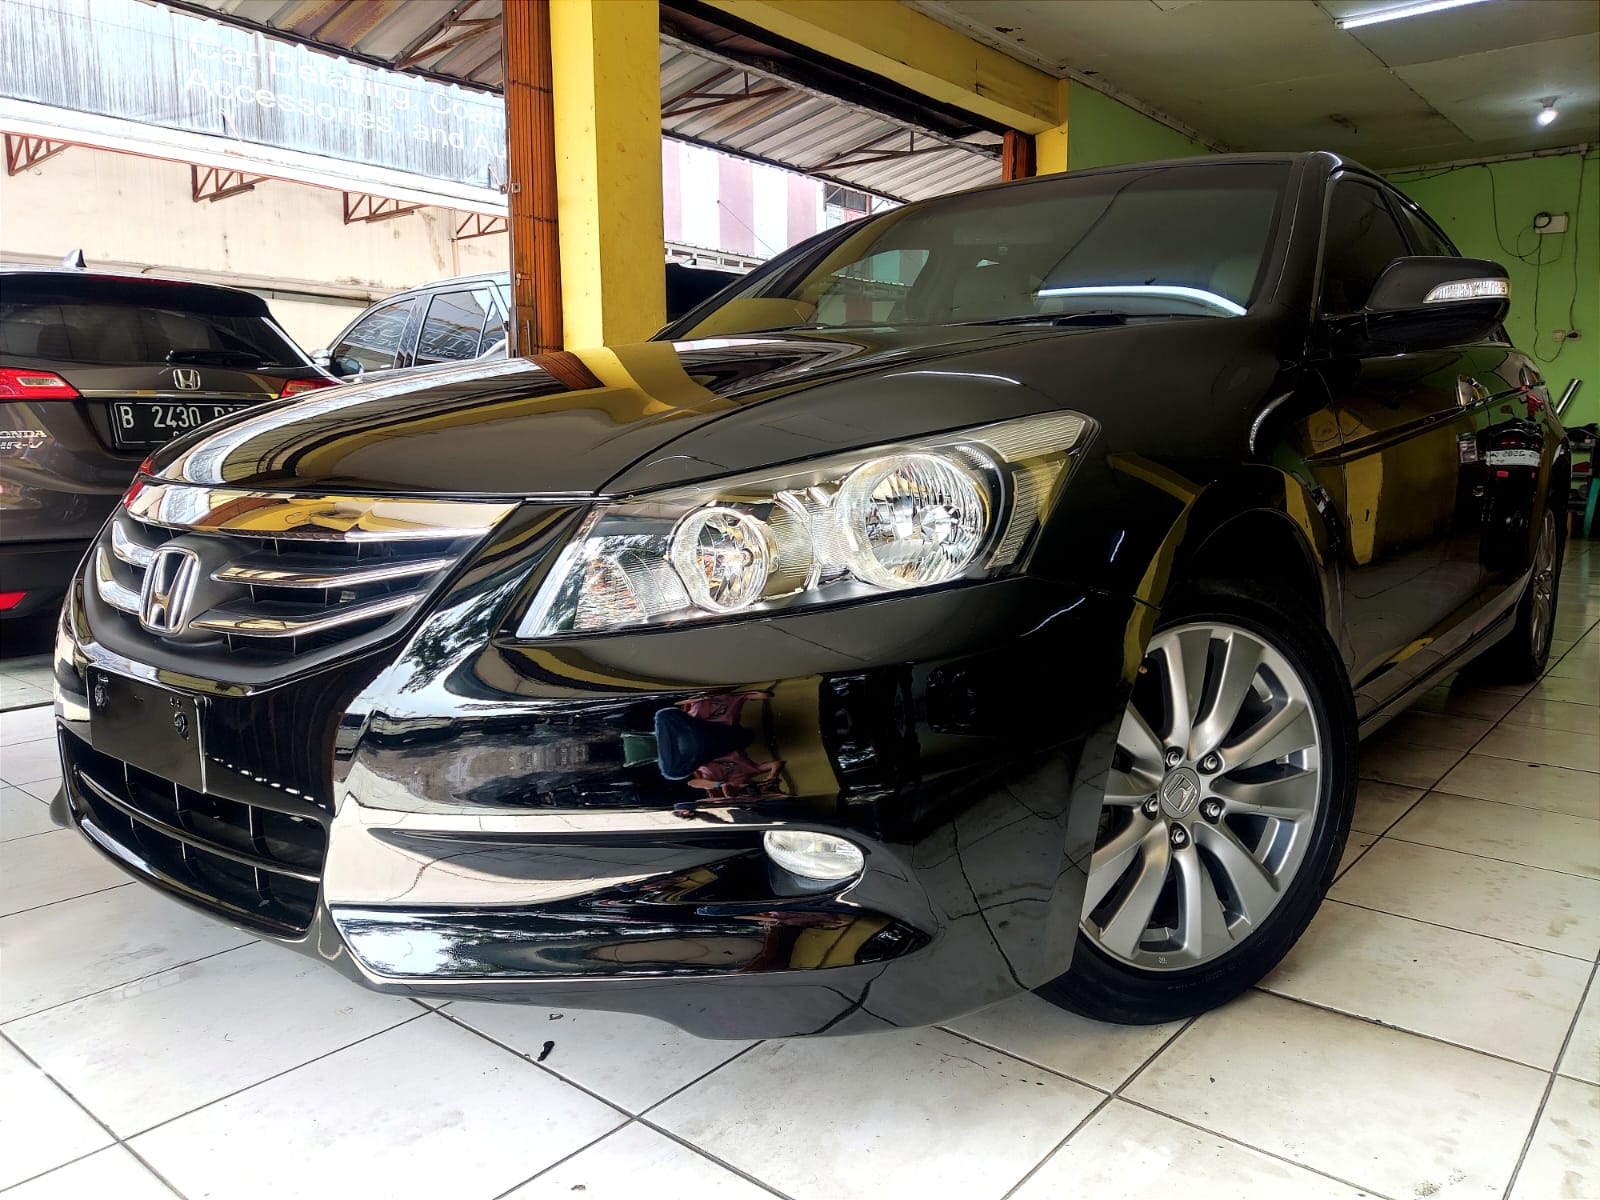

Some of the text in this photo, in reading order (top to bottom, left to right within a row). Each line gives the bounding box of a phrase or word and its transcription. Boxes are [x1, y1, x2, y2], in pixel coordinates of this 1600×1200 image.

[190, 33, 259, 70] Car
[413, 123, 465, 150] and
[119, 405, 135, 429] B
[151, 405, 201, 428] 2430
